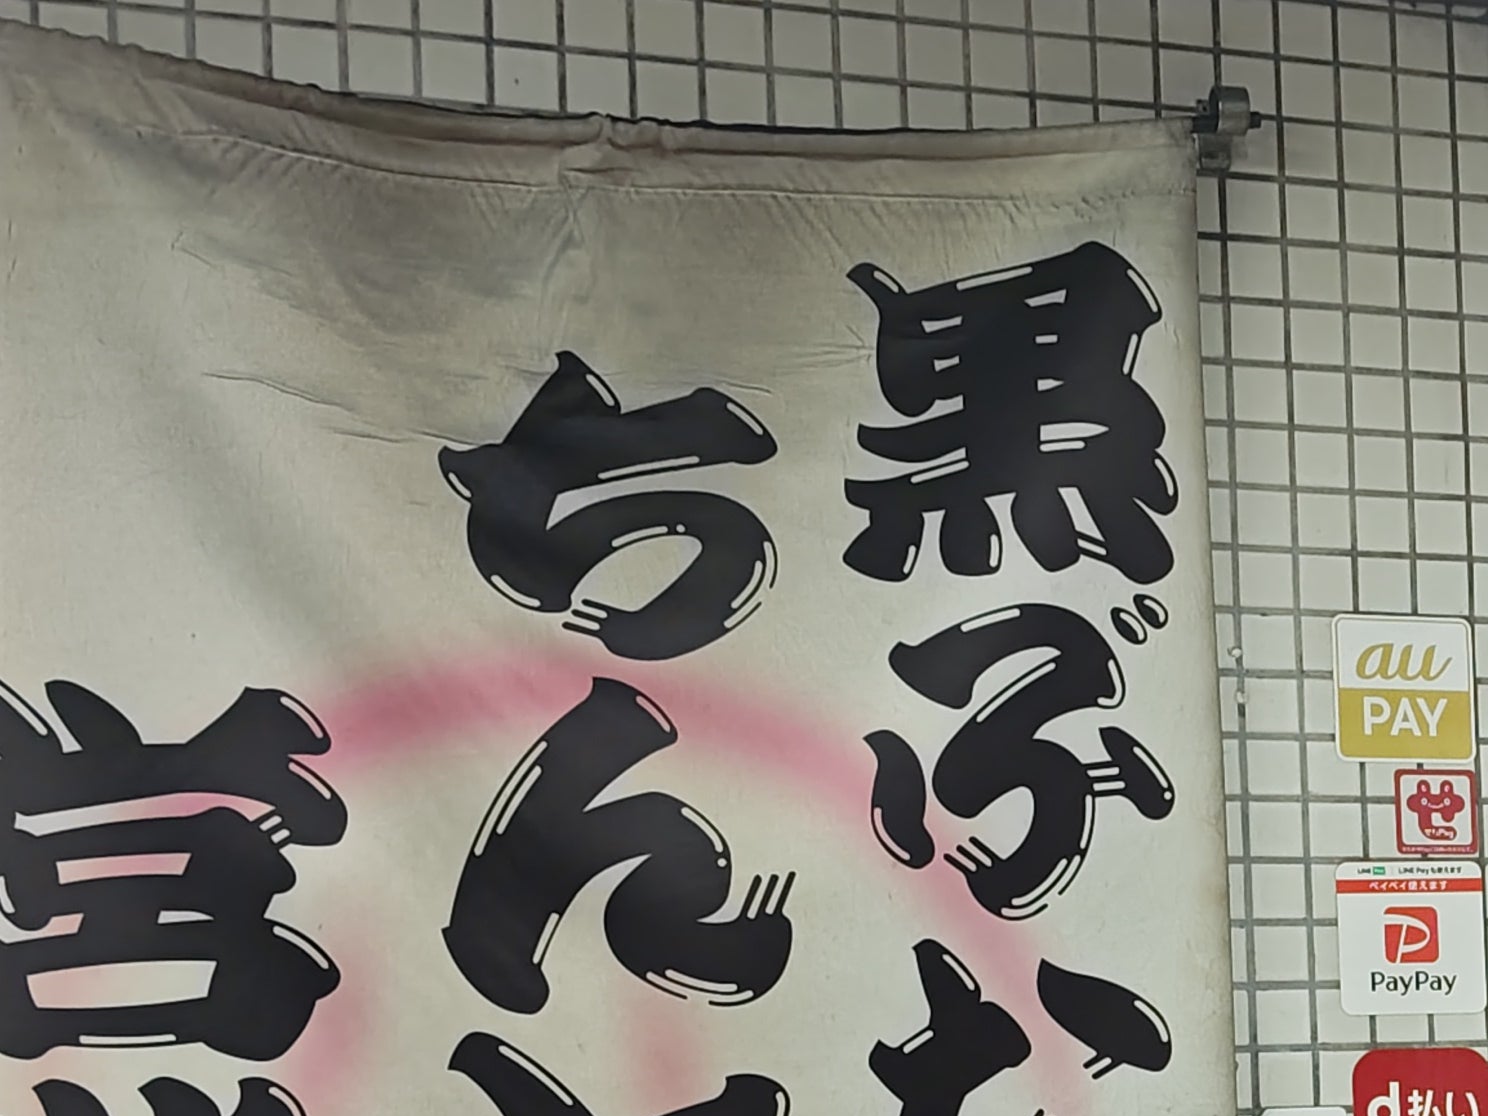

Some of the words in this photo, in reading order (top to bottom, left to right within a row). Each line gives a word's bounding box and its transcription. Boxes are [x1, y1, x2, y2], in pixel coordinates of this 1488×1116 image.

[1356, 643, 1452, 681] au
[1364, 696, 1448, 736] PAY
[1371, 971, 1457, 995] PayPay
